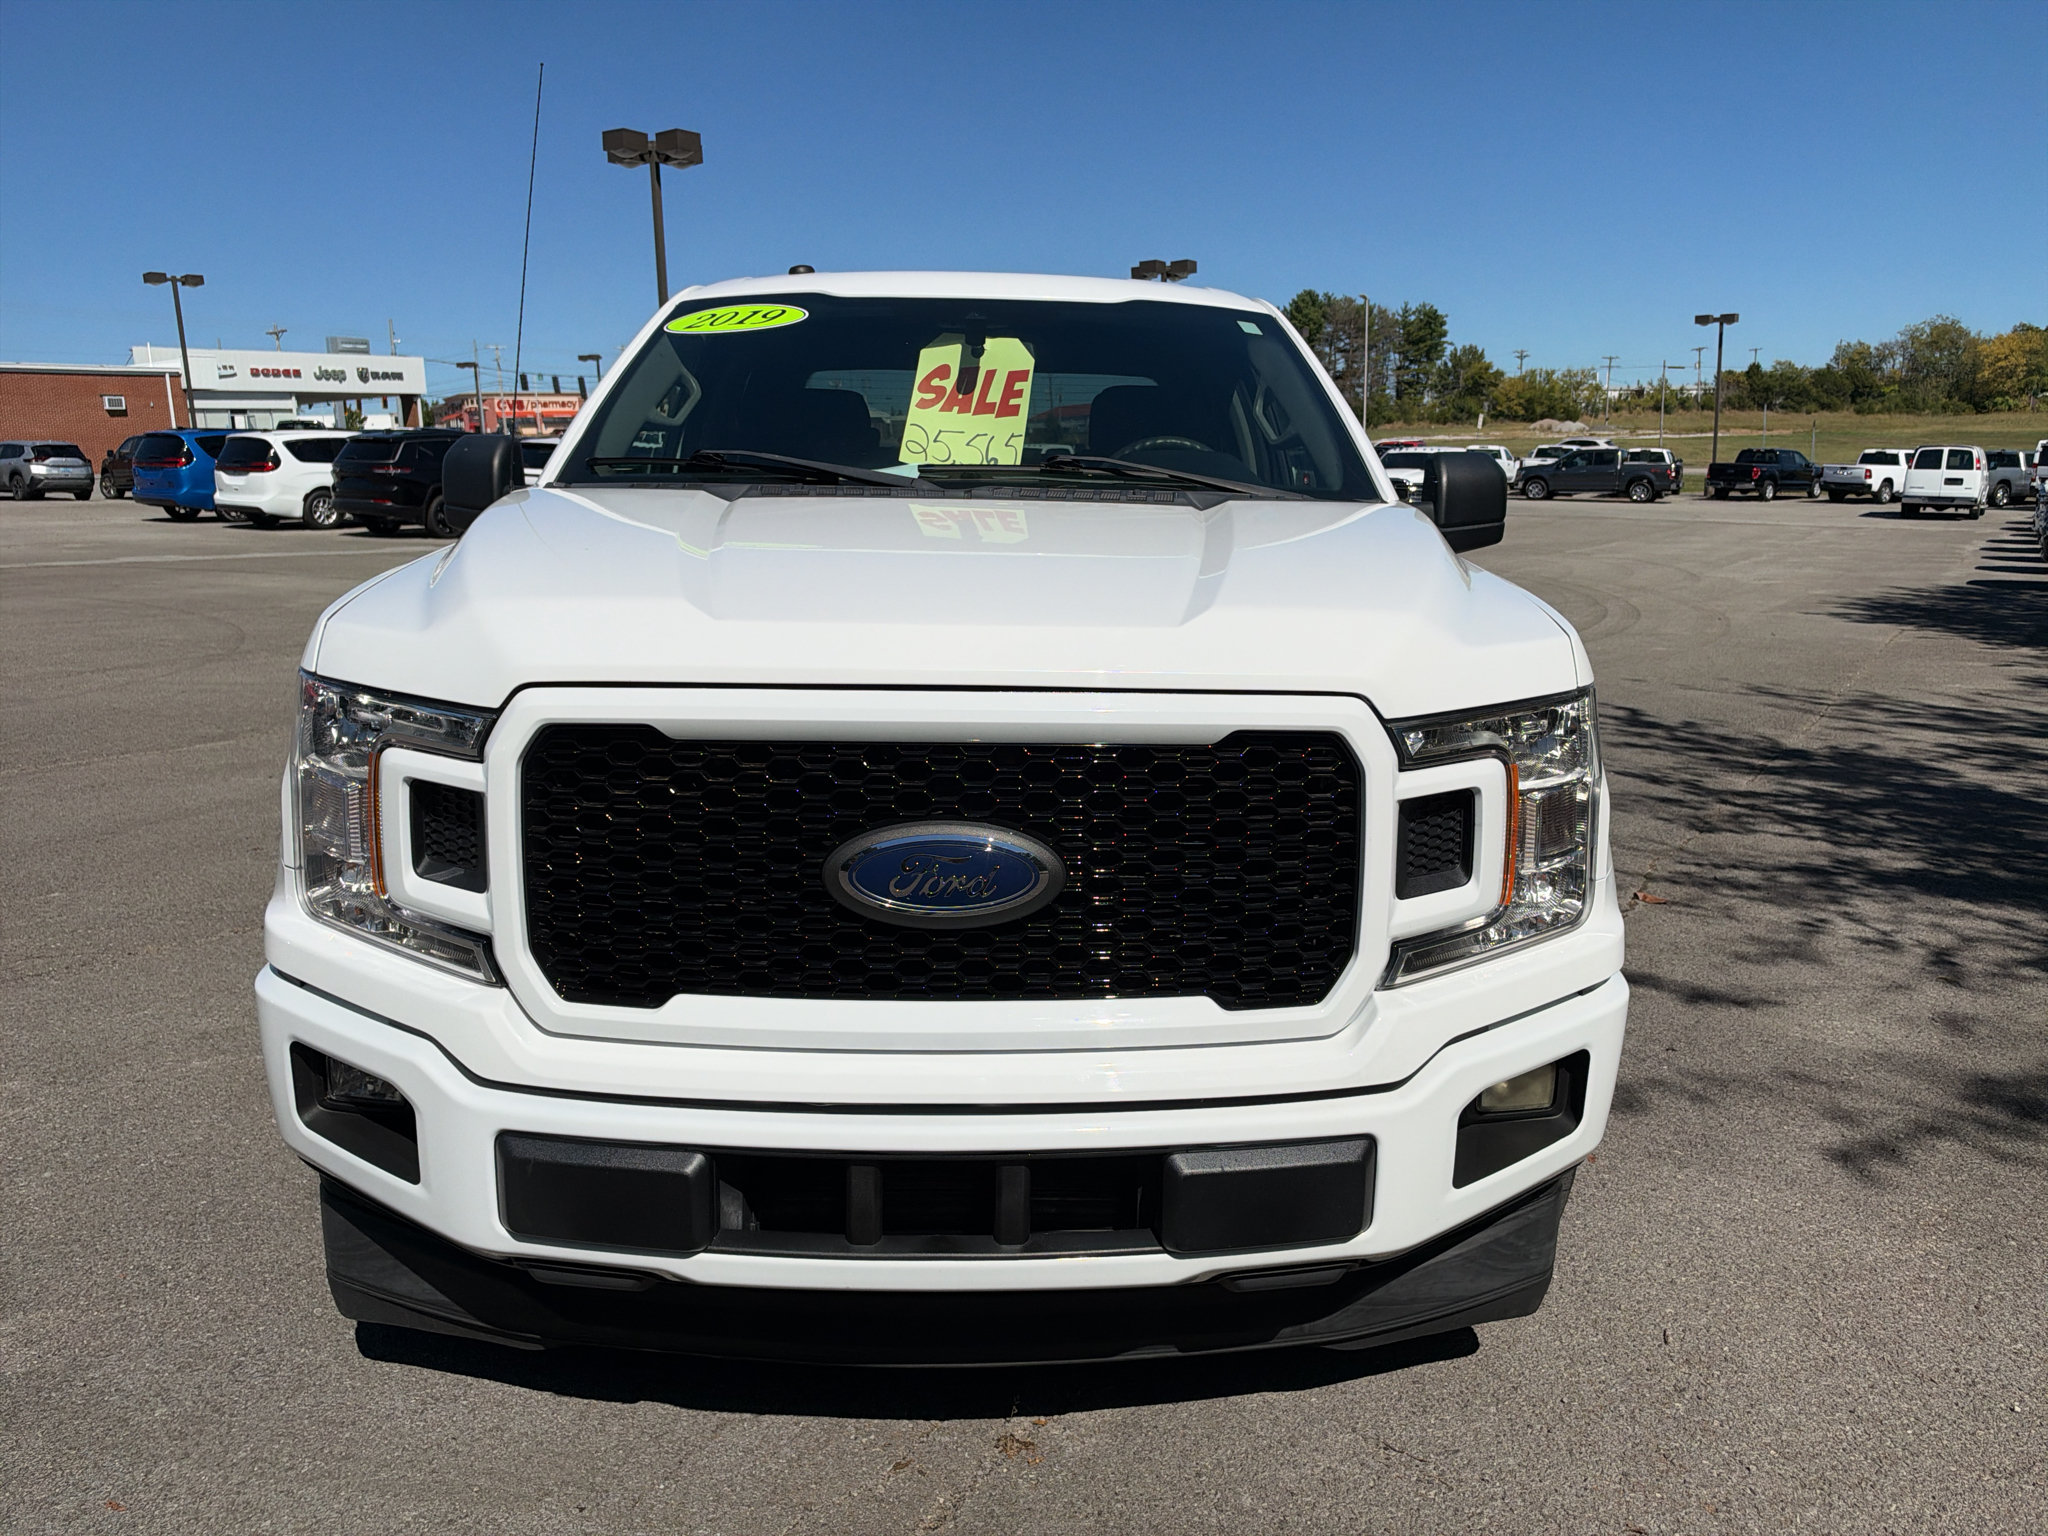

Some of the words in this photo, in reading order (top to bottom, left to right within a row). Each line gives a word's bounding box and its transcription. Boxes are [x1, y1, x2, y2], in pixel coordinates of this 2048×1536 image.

[683, 308, 787, 330] 2019
[250, 367, 302, 378] DODGE
[313, 366, 347, 384] Jeep
[371, 371, 404, 381] RAM
[915, 363, 1030, 418] SALE
[889, 853, 1000, 898] Ford
